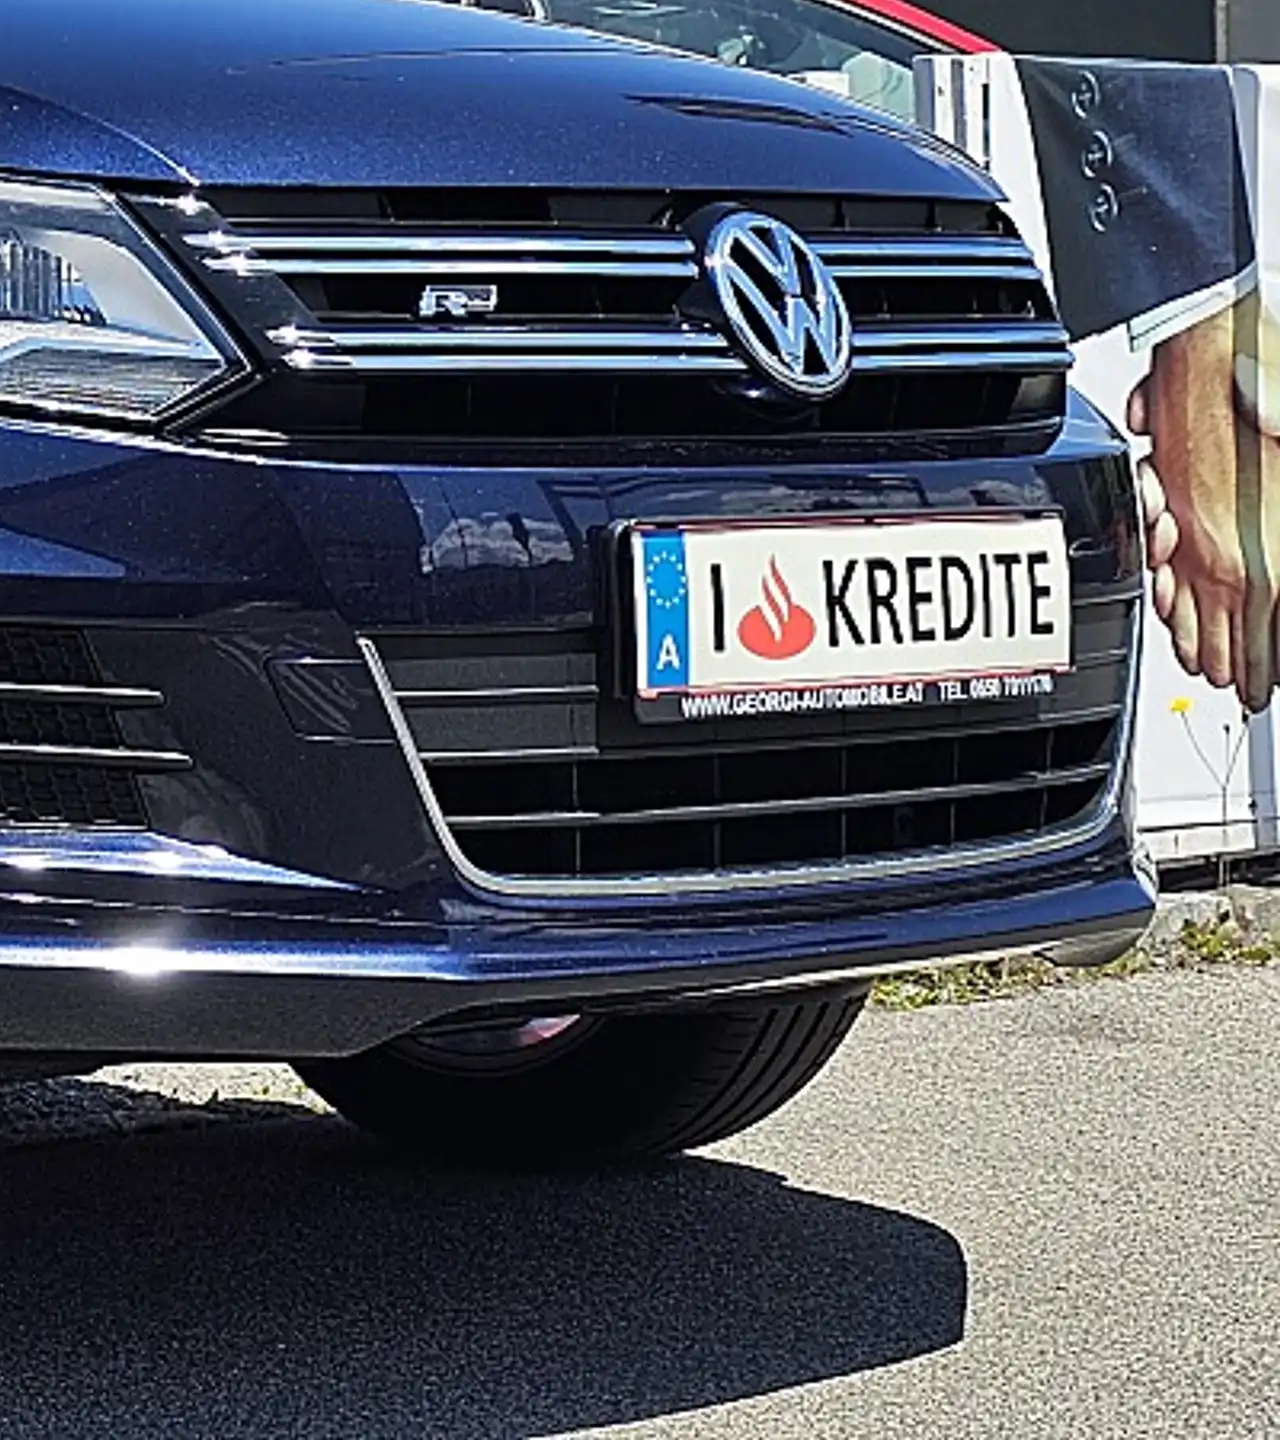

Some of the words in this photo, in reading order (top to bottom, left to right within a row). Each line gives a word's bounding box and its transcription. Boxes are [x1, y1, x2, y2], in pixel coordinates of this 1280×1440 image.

[710, 563, 725, 652] I
[822, 550, 1054, 648] KREDITE
[656, 633, 680, 671] A
